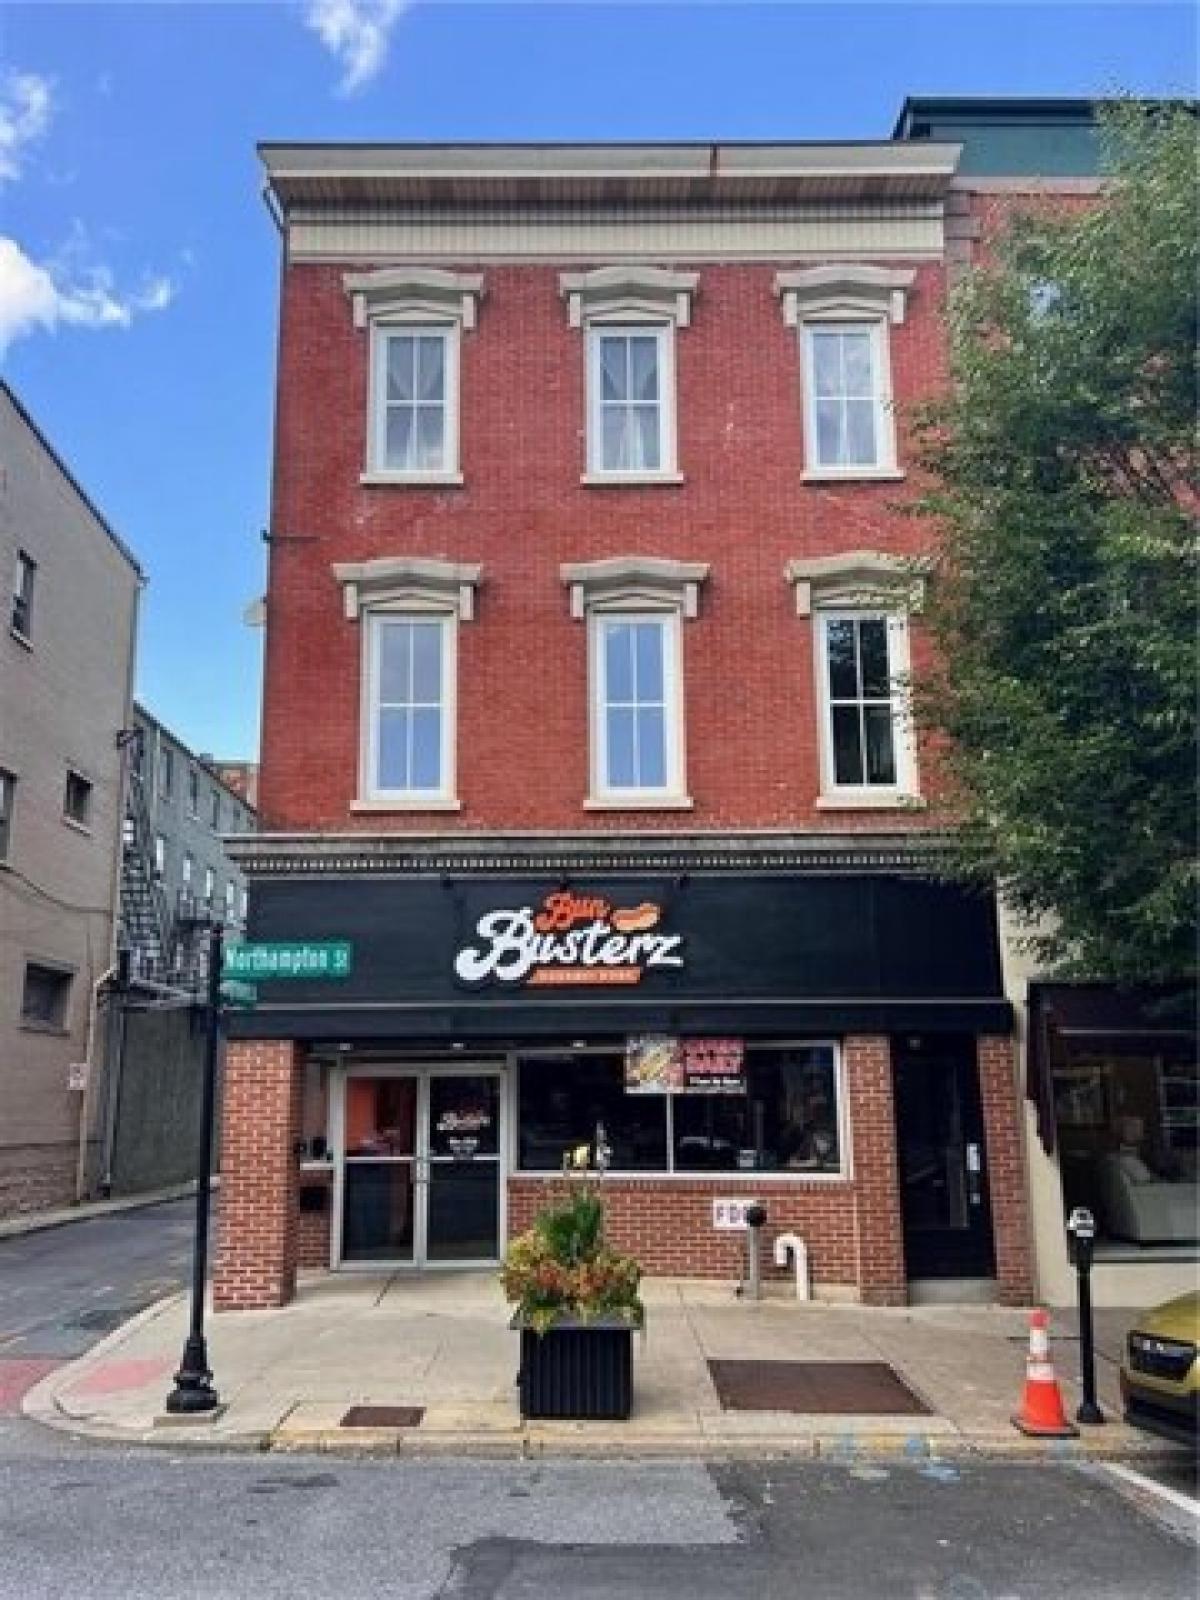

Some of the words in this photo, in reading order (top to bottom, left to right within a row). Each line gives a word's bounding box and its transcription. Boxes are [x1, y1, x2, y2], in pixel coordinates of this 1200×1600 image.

[534, 892, 610, 930] Bun
[225, 946, 327, 973] Northampton
[455, 906, 684, 980] Busterz
